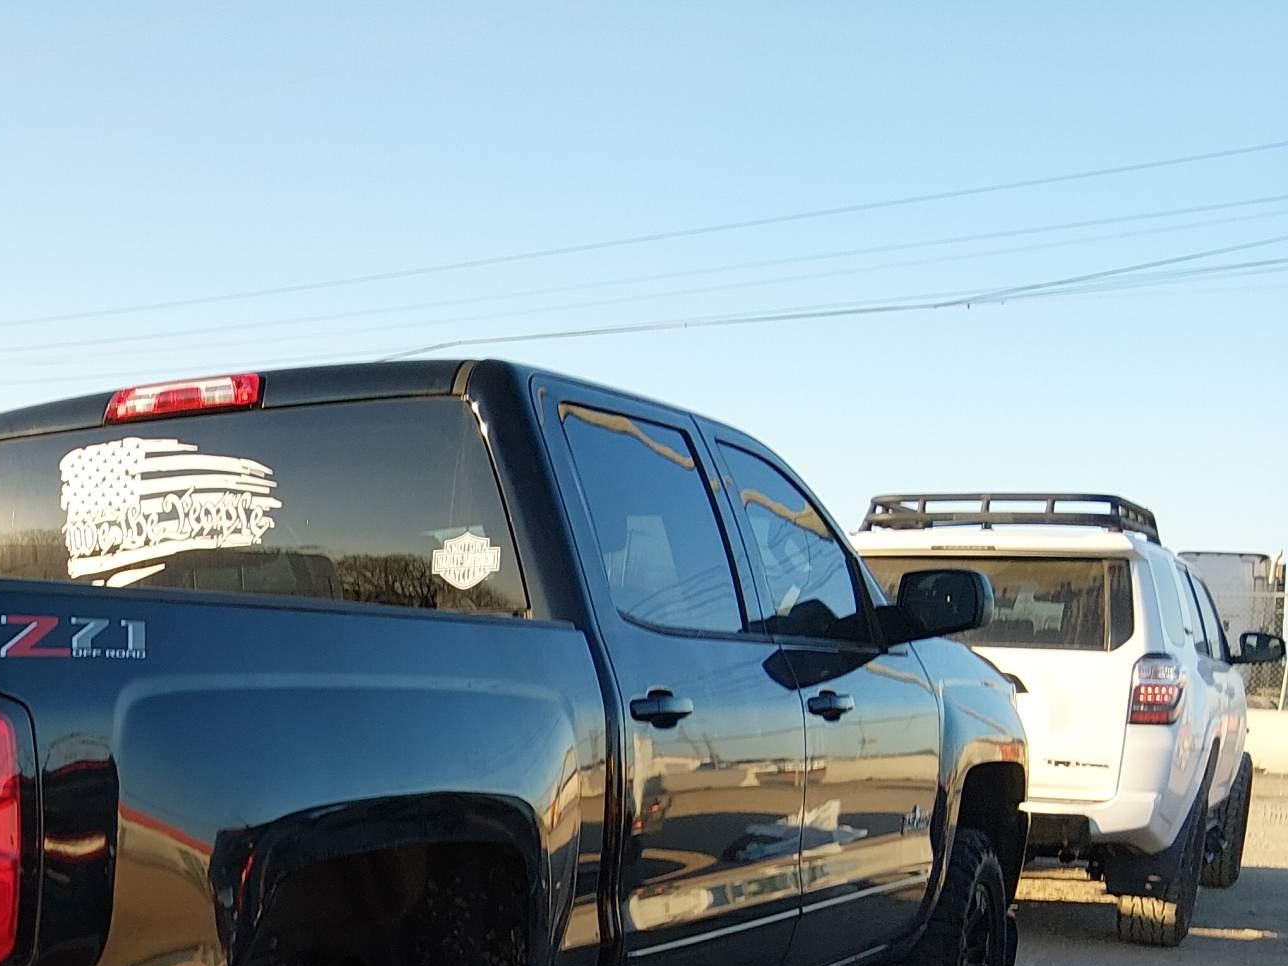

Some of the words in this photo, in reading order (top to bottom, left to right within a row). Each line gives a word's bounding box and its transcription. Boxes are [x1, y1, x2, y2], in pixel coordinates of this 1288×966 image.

[62, 517, 122, 556] We
[161, 486, 274, 547] People
[0, 614, 146, 658] Z71
[72, 648, 101, 658] OFF
[105, 648, 146, 659] ROAD
